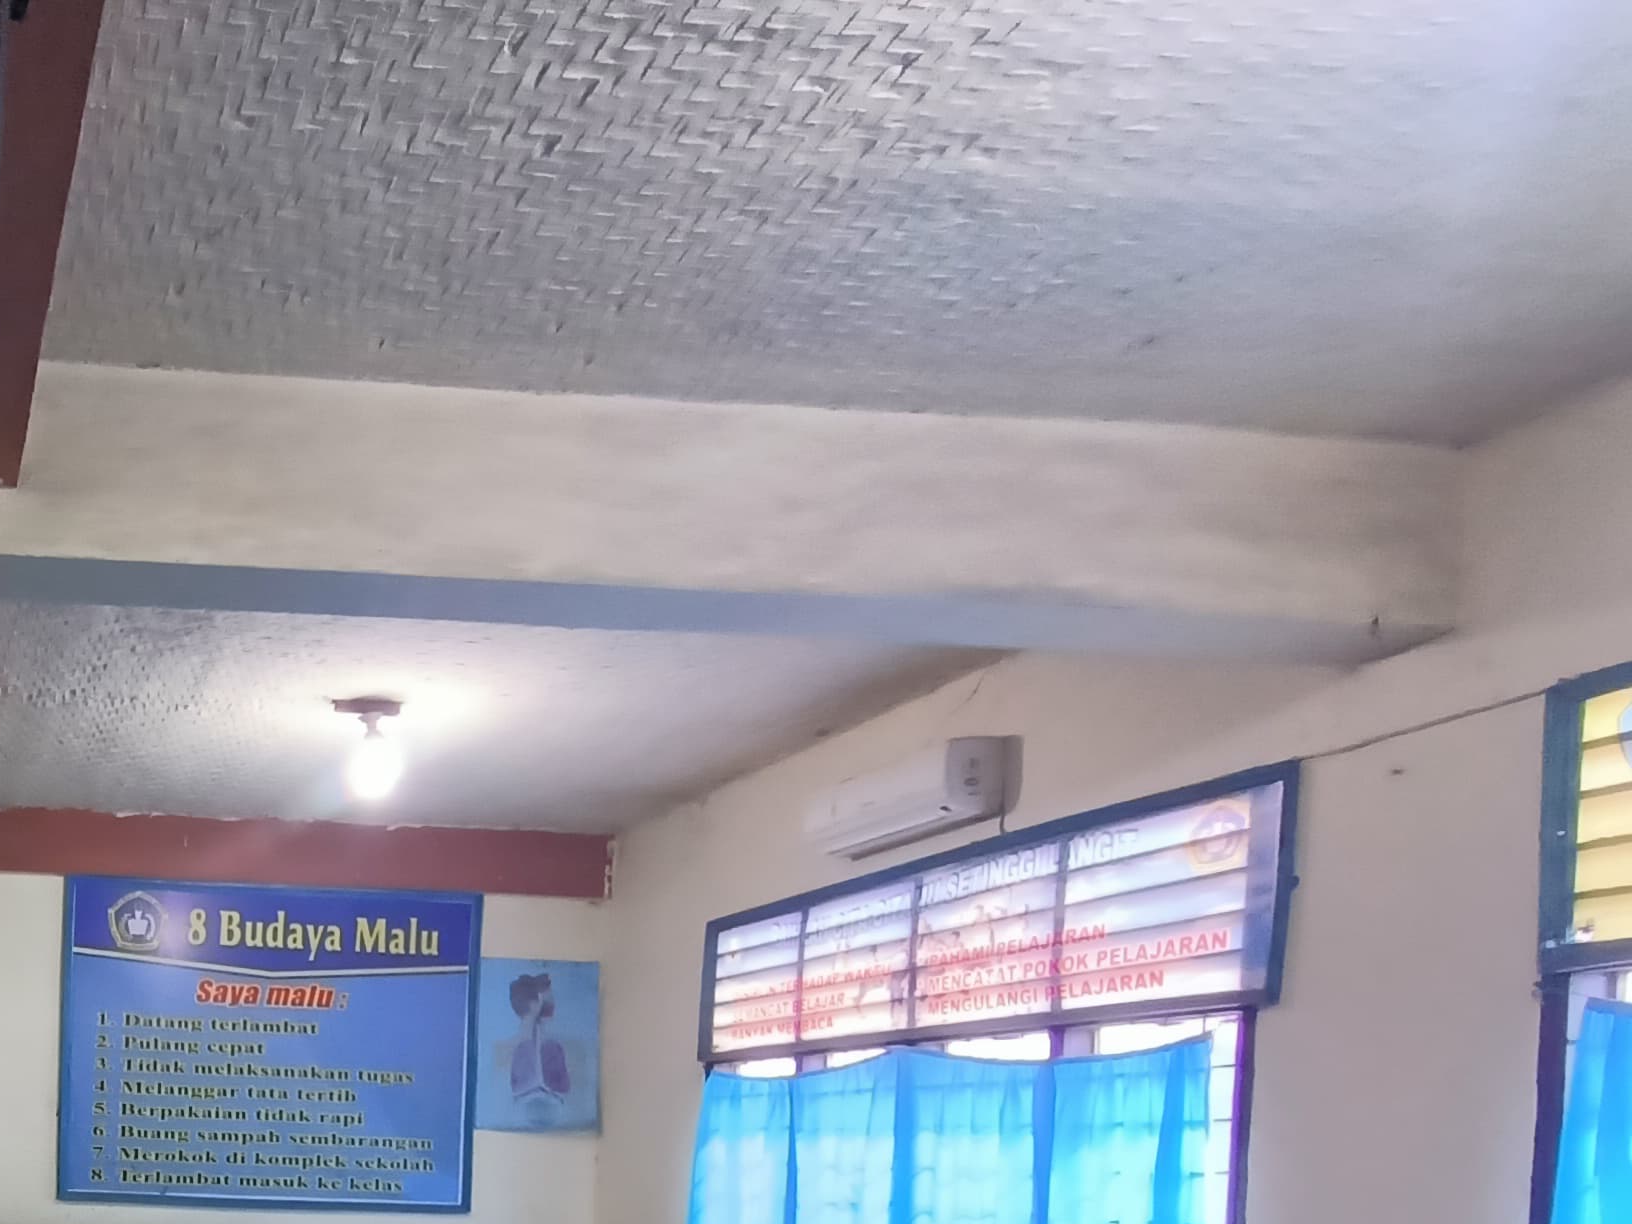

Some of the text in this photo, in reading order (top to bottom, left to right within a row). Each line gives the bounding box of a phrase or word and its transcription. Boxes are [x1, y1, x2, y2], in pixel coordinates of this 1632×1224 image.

[187, 907, 439, 961] 8 Budaya Malu
[999, 924, 1106, 956] PELAJARAN
[927, 931, 1229, 993] MENCATAT POKOK PELAJARAN
[195, 978, 261, 1009] Saya
[266, 983, 336, 1009] malu
[926, 970, 1165, 1016] MENGULANGI PELAJARAN
[123, 1013, 203, 1033] Datang
[210, 1017, 318, 1035] terlambat
[123, 1035, 201, 1055] Pulang
[207, 1042, 265, 1057] cepat
[123, 1057, 186, 1074] Tidak
[193, 1062, 350, 1082] melaksanakan
[356, 1068, 415, 1084] tugas
[122, 1080, 240, 1099] Melanggar
[247, 1086, 289, 1100] tata
[297, 1088, 357, 1103] tertib
[120, 1103, 247, 1121] Berpakaian
[255, 1108, 311, 1124] tidak
[319, 1112, 364, 1128] rapi
[120, 1125, 190, 1143] Buang
[197, 1130, 281, 1146] sampah
[288, 1132, 434, 1151] sembarangan
[119, 1147, 218, 1164] Merokok
[225, 1151, 247, 1165] di
[254, 1152, 348, 1171] komplek
[354, 1157, 435, 1173] sekolah
[120, 1169, 231, 1187] Terlambat
[239, 1174, 310, 1189] masuk
[317, 1176, 342, 1190] ke
[349, 1178, 404, 1192] kelas
